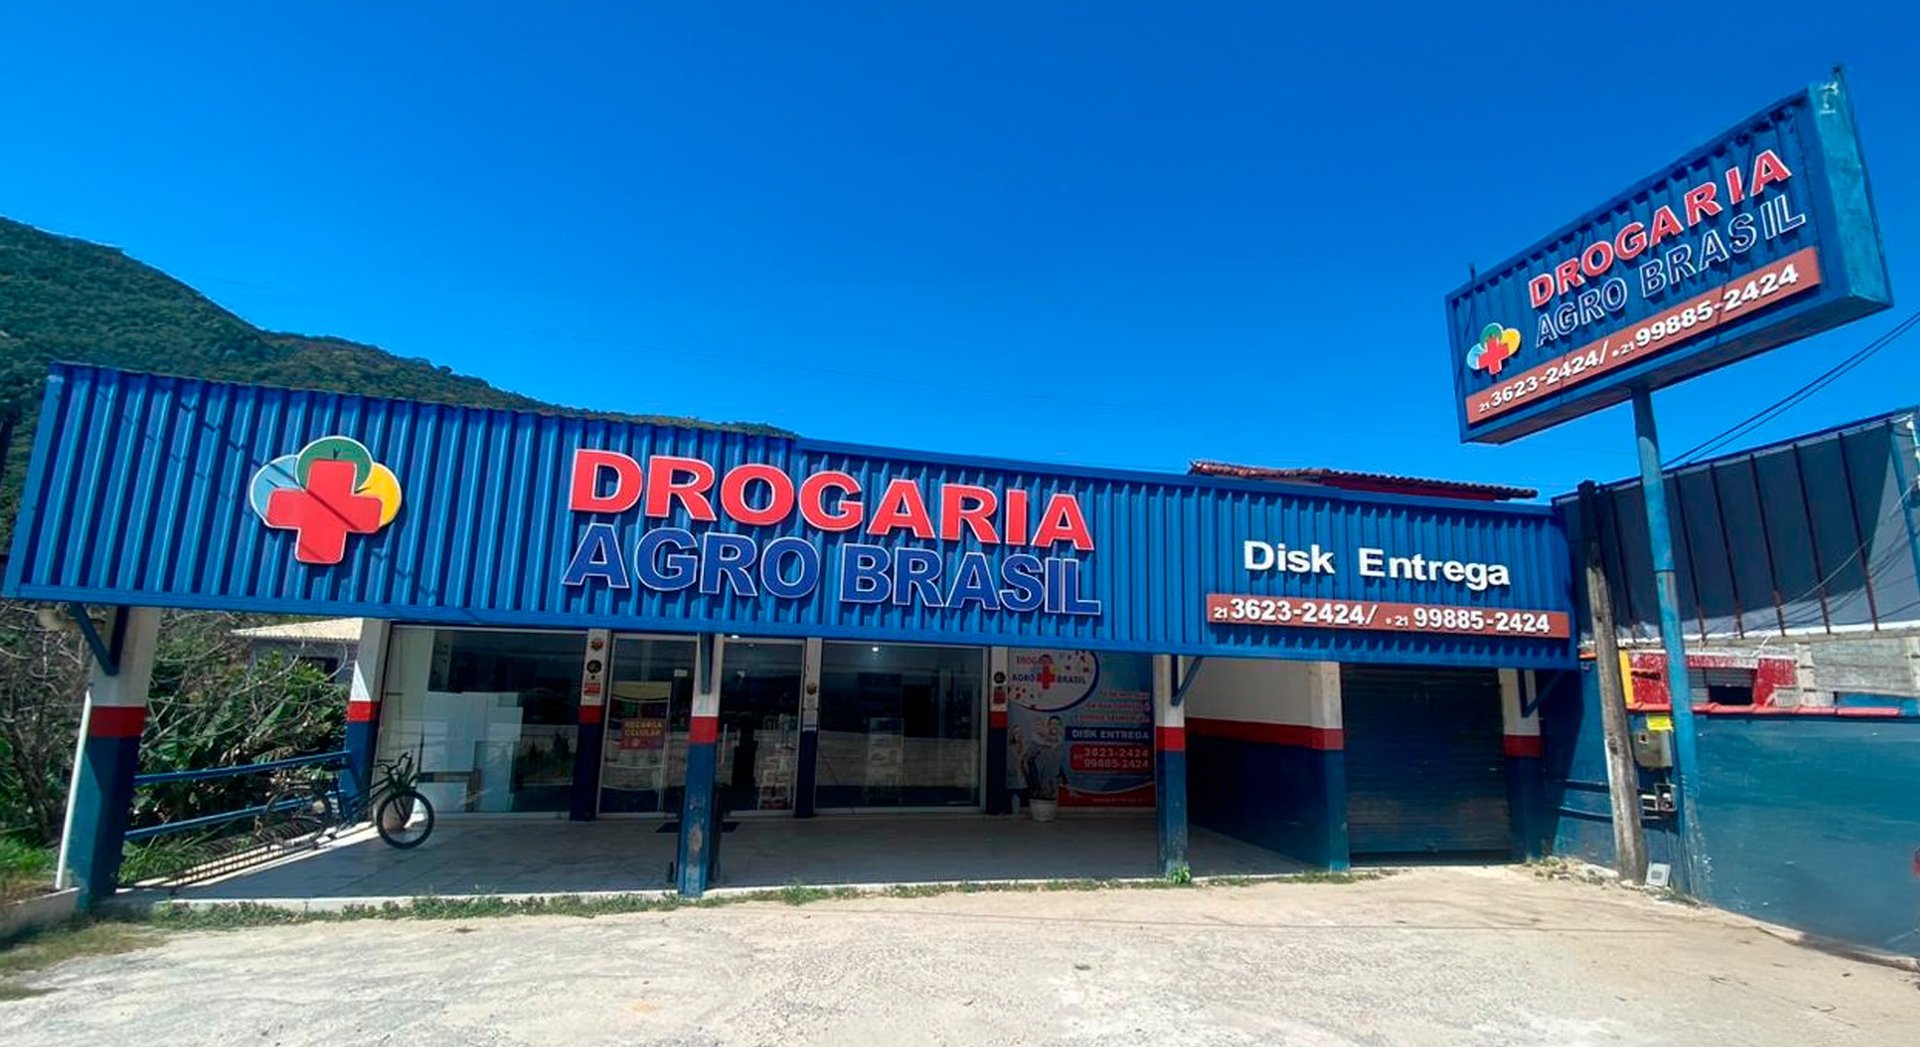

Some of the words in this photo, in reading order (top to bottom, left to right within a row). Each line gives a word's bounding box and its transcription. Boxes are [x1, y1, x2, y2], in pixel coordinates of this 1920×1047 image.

[1528, 149, 1792, 308] DROGARIA
[1535, 277, 1627, 348] AGRO
[1639, 194, 1806, 298] BRASIL
[1635, 263, 1799, 346] 99885-2424
[568, 448, 1095, 550] DROGARIA
[561, 522, 820, 598] AGRO
[839, 543, 1101, 615] BRASIL
[1243, 540, 1335, 574] Disk
[1358, 547, 1511, 591] Entrega
[1213, 607, 1228, 618] 21
[1413, 607, 1550, 634] 99885-2424
